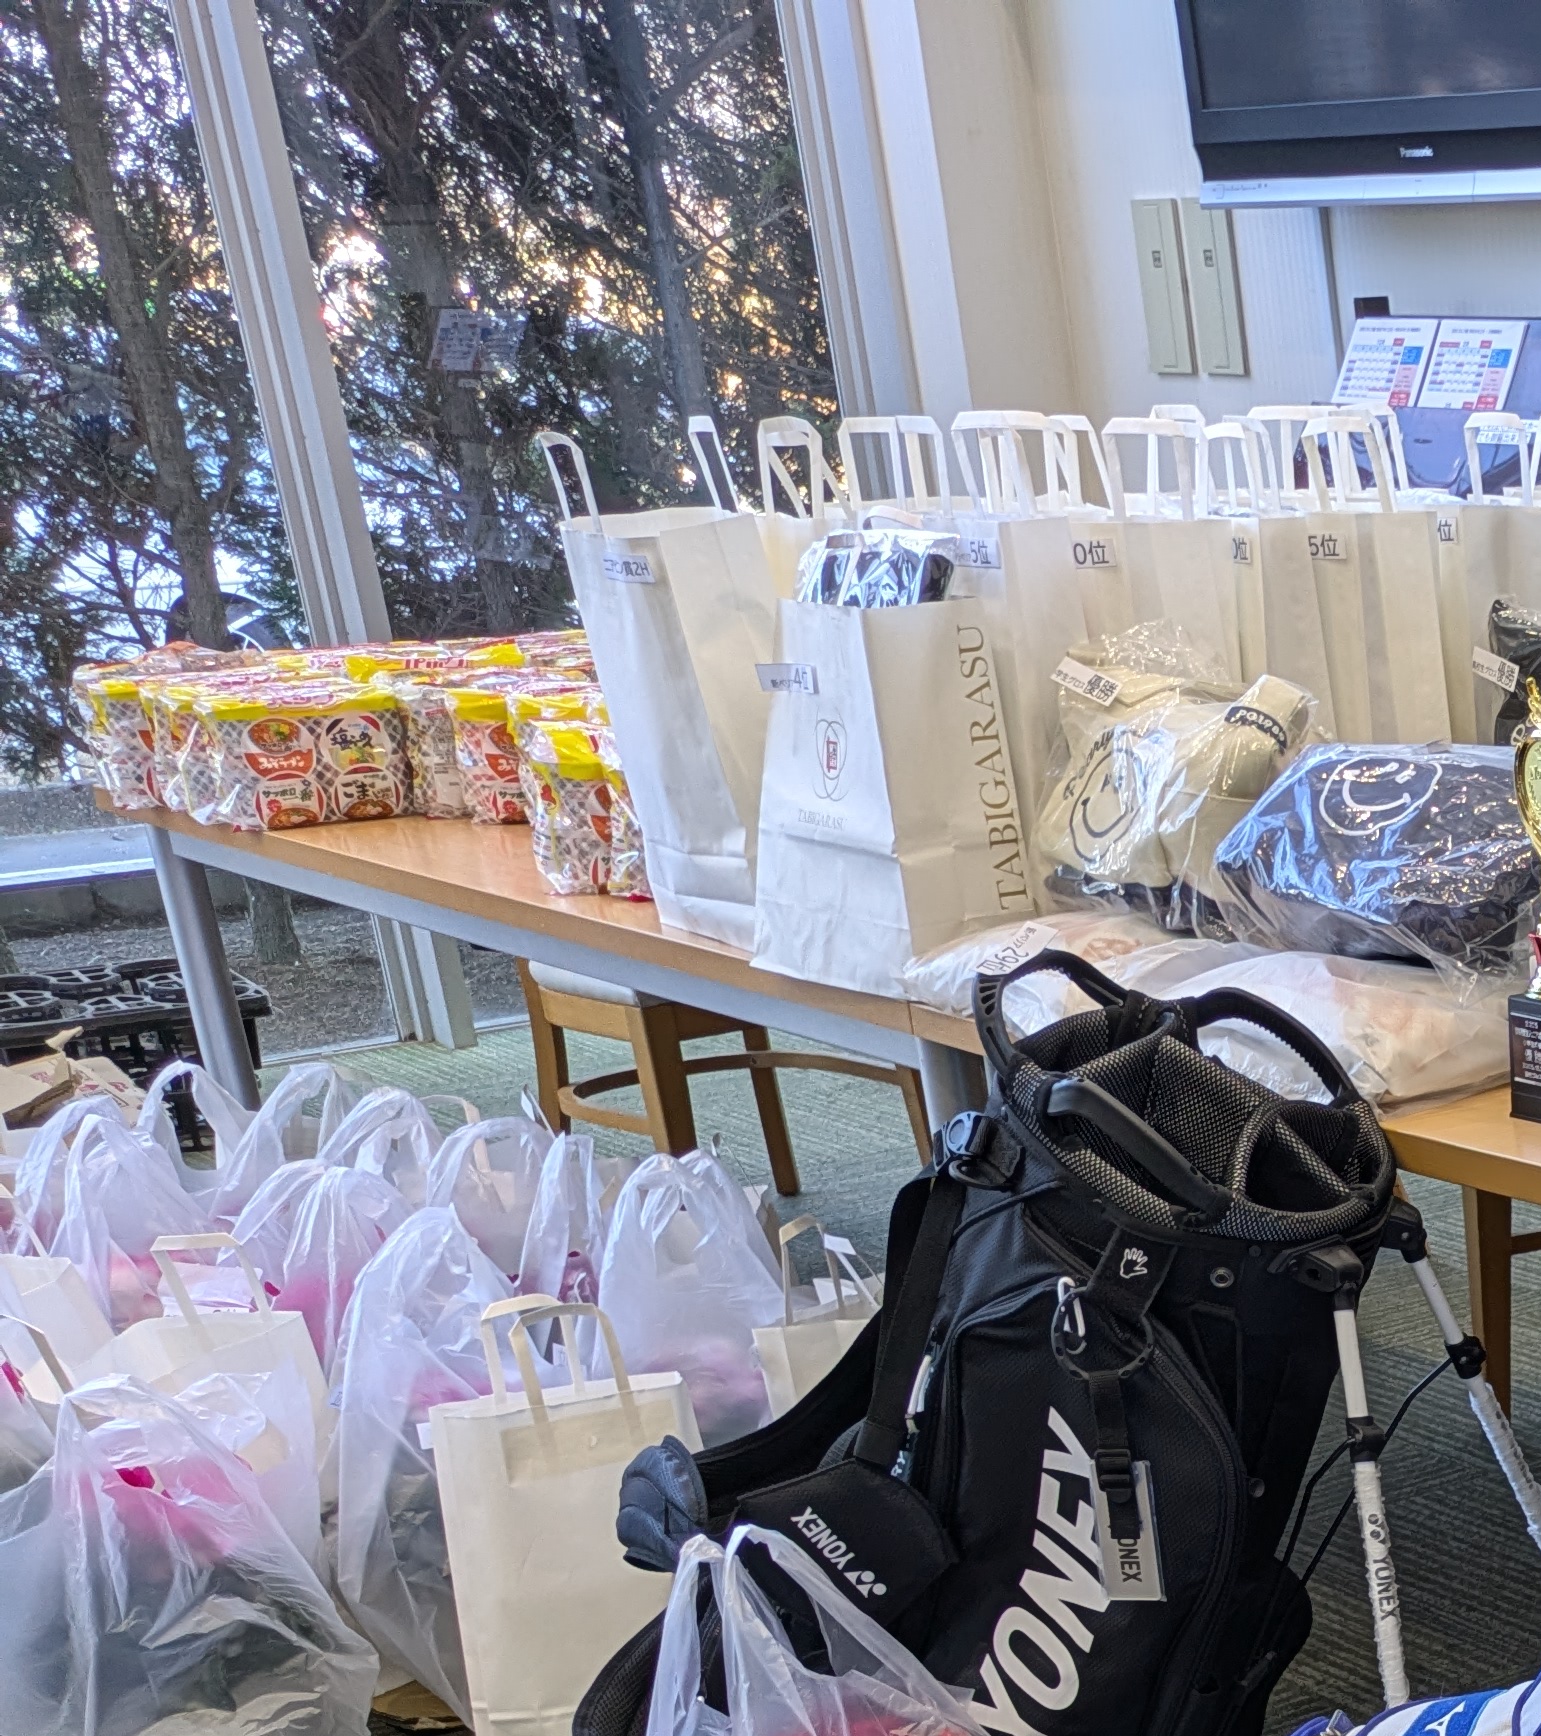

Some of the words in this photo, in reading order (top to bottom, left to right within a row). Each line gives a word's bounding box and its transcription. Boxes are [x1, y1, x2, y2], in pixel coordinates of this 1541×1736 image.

[1085, 672, 1119, 704] 優勝
[956, 624, 1029, 911] TABIGARASU
[797, 808, 848, 831] TABIGARASU
[790, 1505, 857, 1573] YONEX
[1371, 1556, 1399, 1624] YONEX
